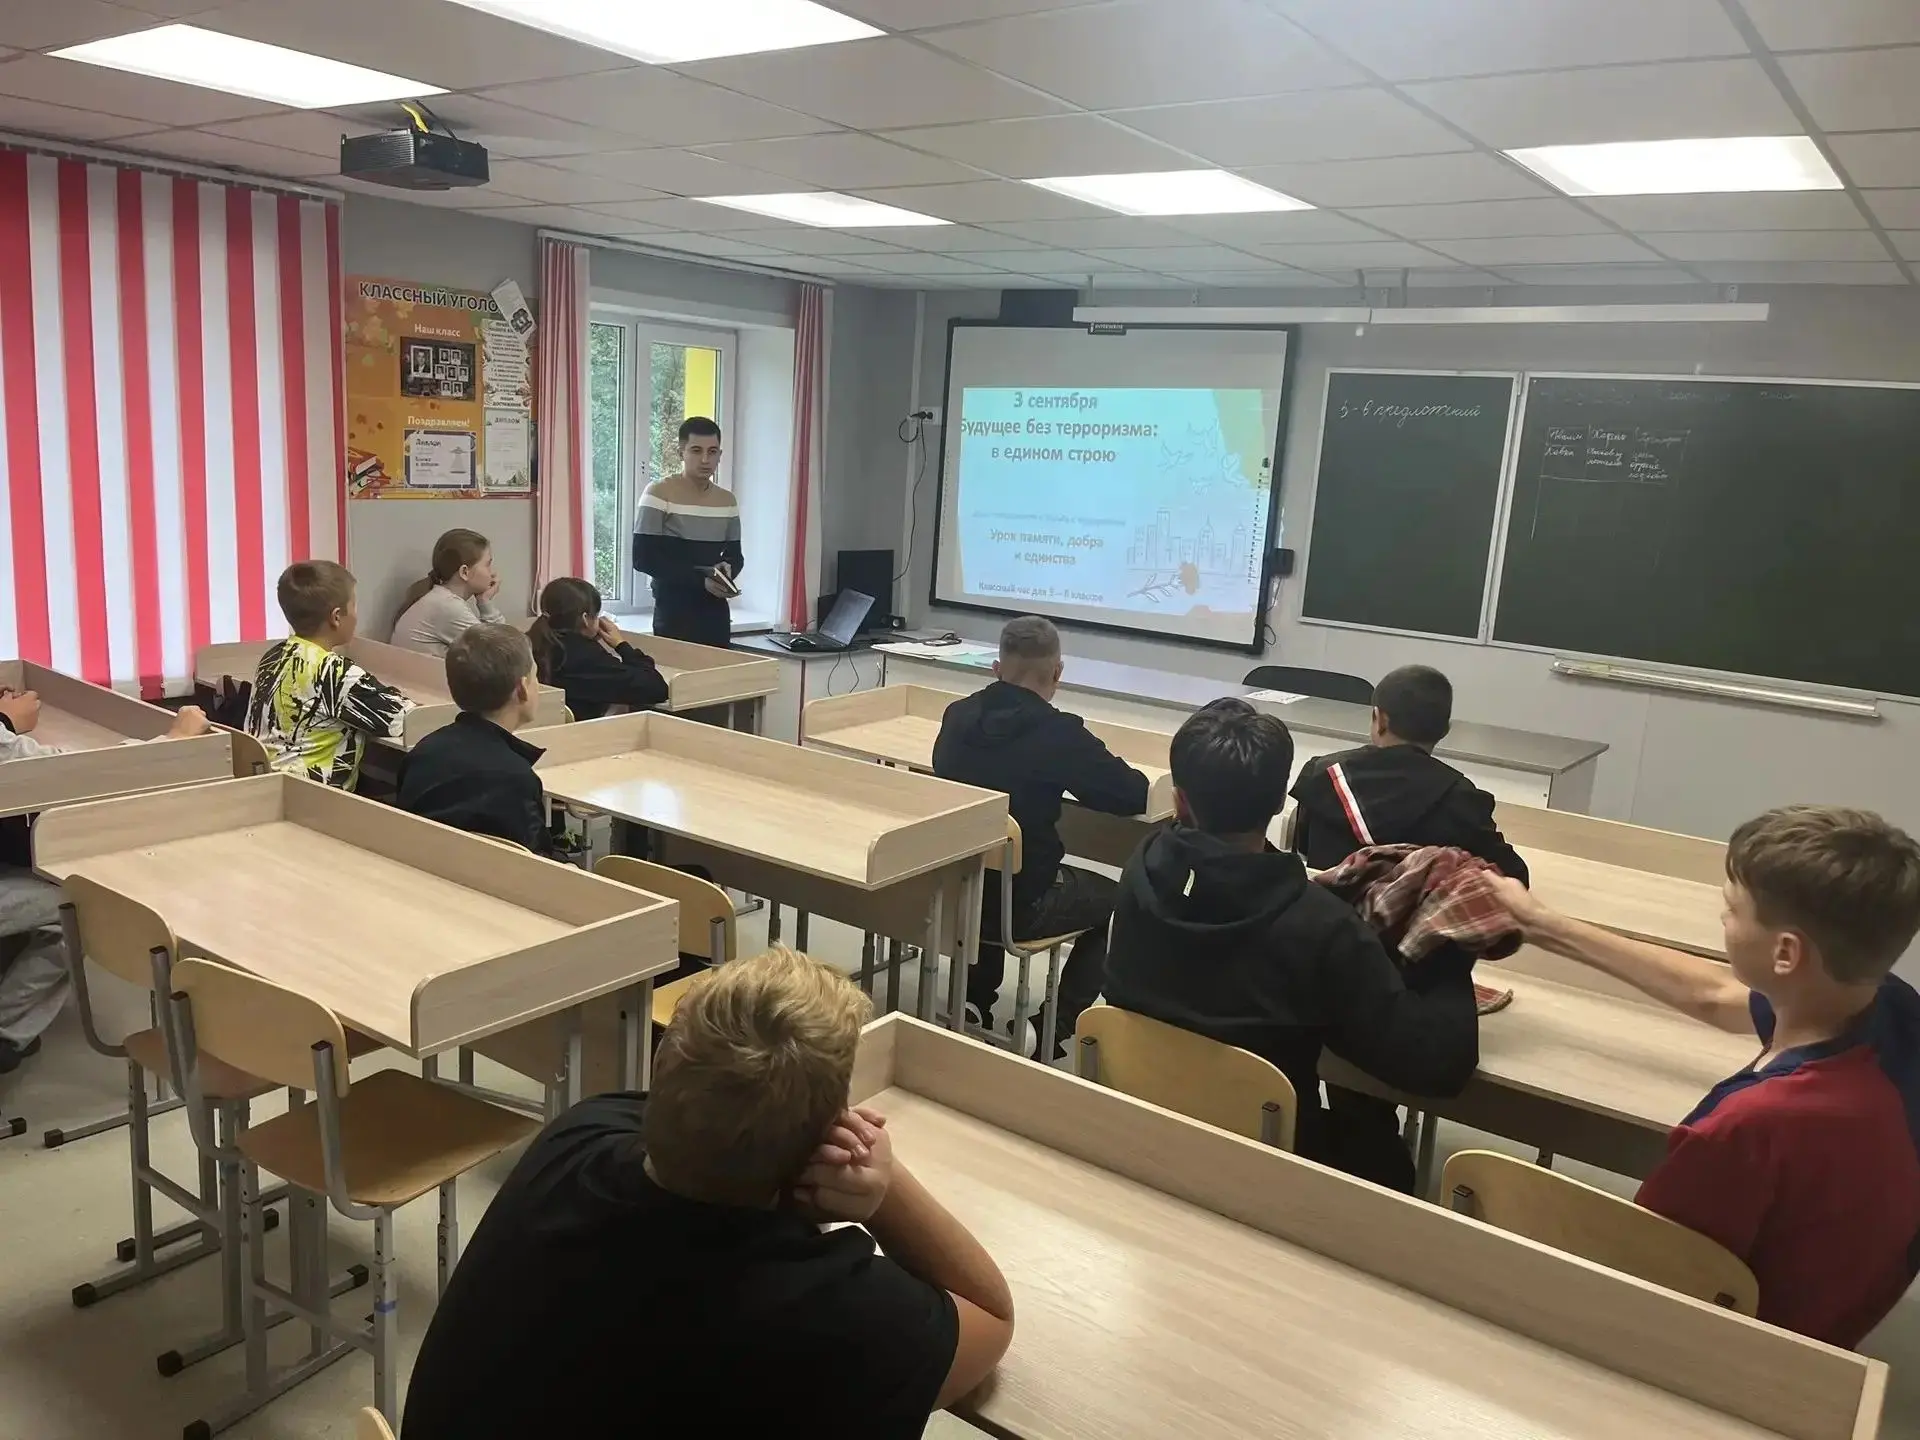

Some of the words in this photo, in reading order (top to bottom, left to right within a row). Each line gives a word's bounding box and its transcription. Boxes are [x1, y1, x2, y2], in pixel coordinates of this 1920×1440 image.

[359, 281, 447, 306] КЛАССНЫЙ
[450, 294, 499, 313] УГОЛО
[414, 323, 436, 335] Наш
[438, 328, 460, 337] класс
[1013, 391, 1023, 408] 3
[1027, 392, 1098, 413] сентября
[407, 415, 470, 427] Поздравляем!
[959, 418, 1021, 436] Будущее
[1026, 418, 1051, 434] без
[1055, 422, 1159, 440] терроризма:
[991, 447, 999, 459] в
[1003, 446, 1063, 461] едином
[1068, 449, 1116, 464] строю
[989, 528, 1016, 546] Урок
[1020, 531, 1064, 547] памяти,
[1066, 535, 1104, 549] добра
[1024, 553, 1077, 566] единства
